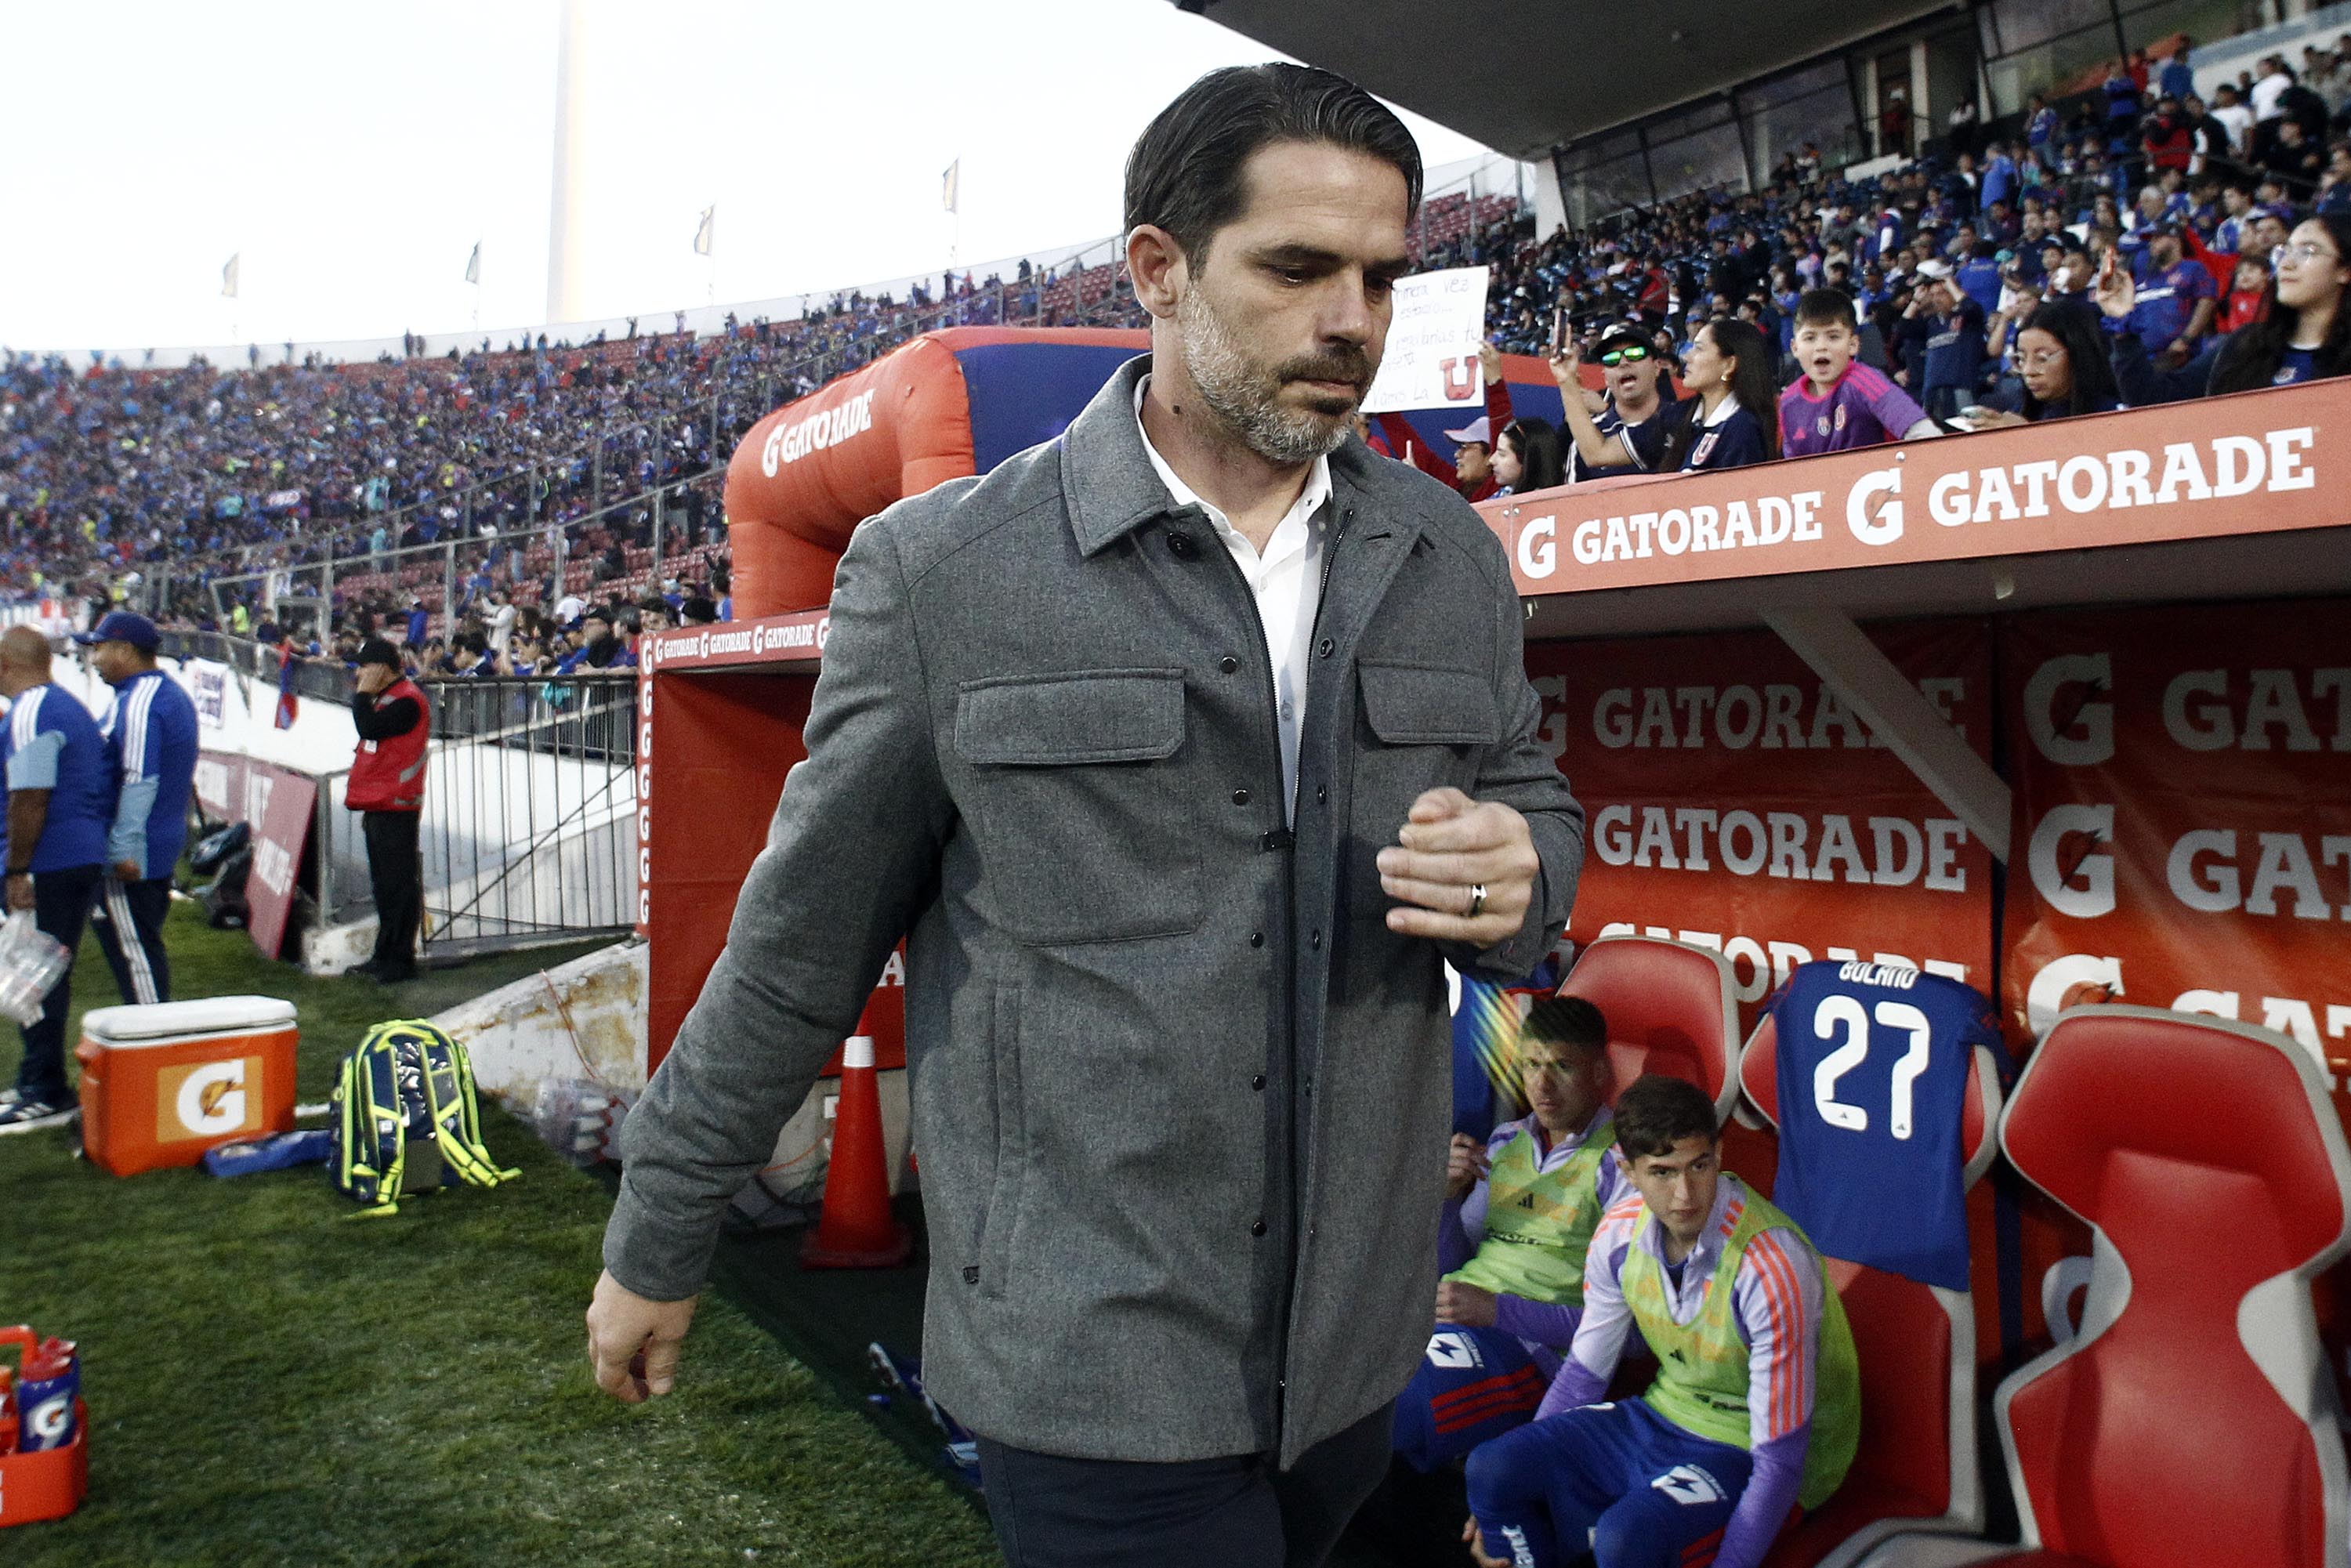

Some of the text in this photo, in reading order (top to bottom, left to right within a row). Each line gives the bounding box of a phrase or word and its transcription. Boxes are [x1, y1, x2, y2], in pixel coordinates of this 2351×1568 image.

[1440, 355, 1479, 400] U
[763, 389, 875, 478] G GATORADE
[1517, 426, 2315, 579] G GATORADE G GATORADE
[665, 636, 699, 658] GATORADE
[701, 632, 709, 658] G
[710, 631, 752, 654] GATORADE
[753, 625, 764, 654] G
[765, 624, 815, 649] GATORADE
[2024, 652, 2114, 766] G
[1594, 805, 1966, 893] GATORADE
[2028, 804, 2117, 918] G
[177, 1059, 245, 1135] G
[1814, 994, 1930, 1140] 27
